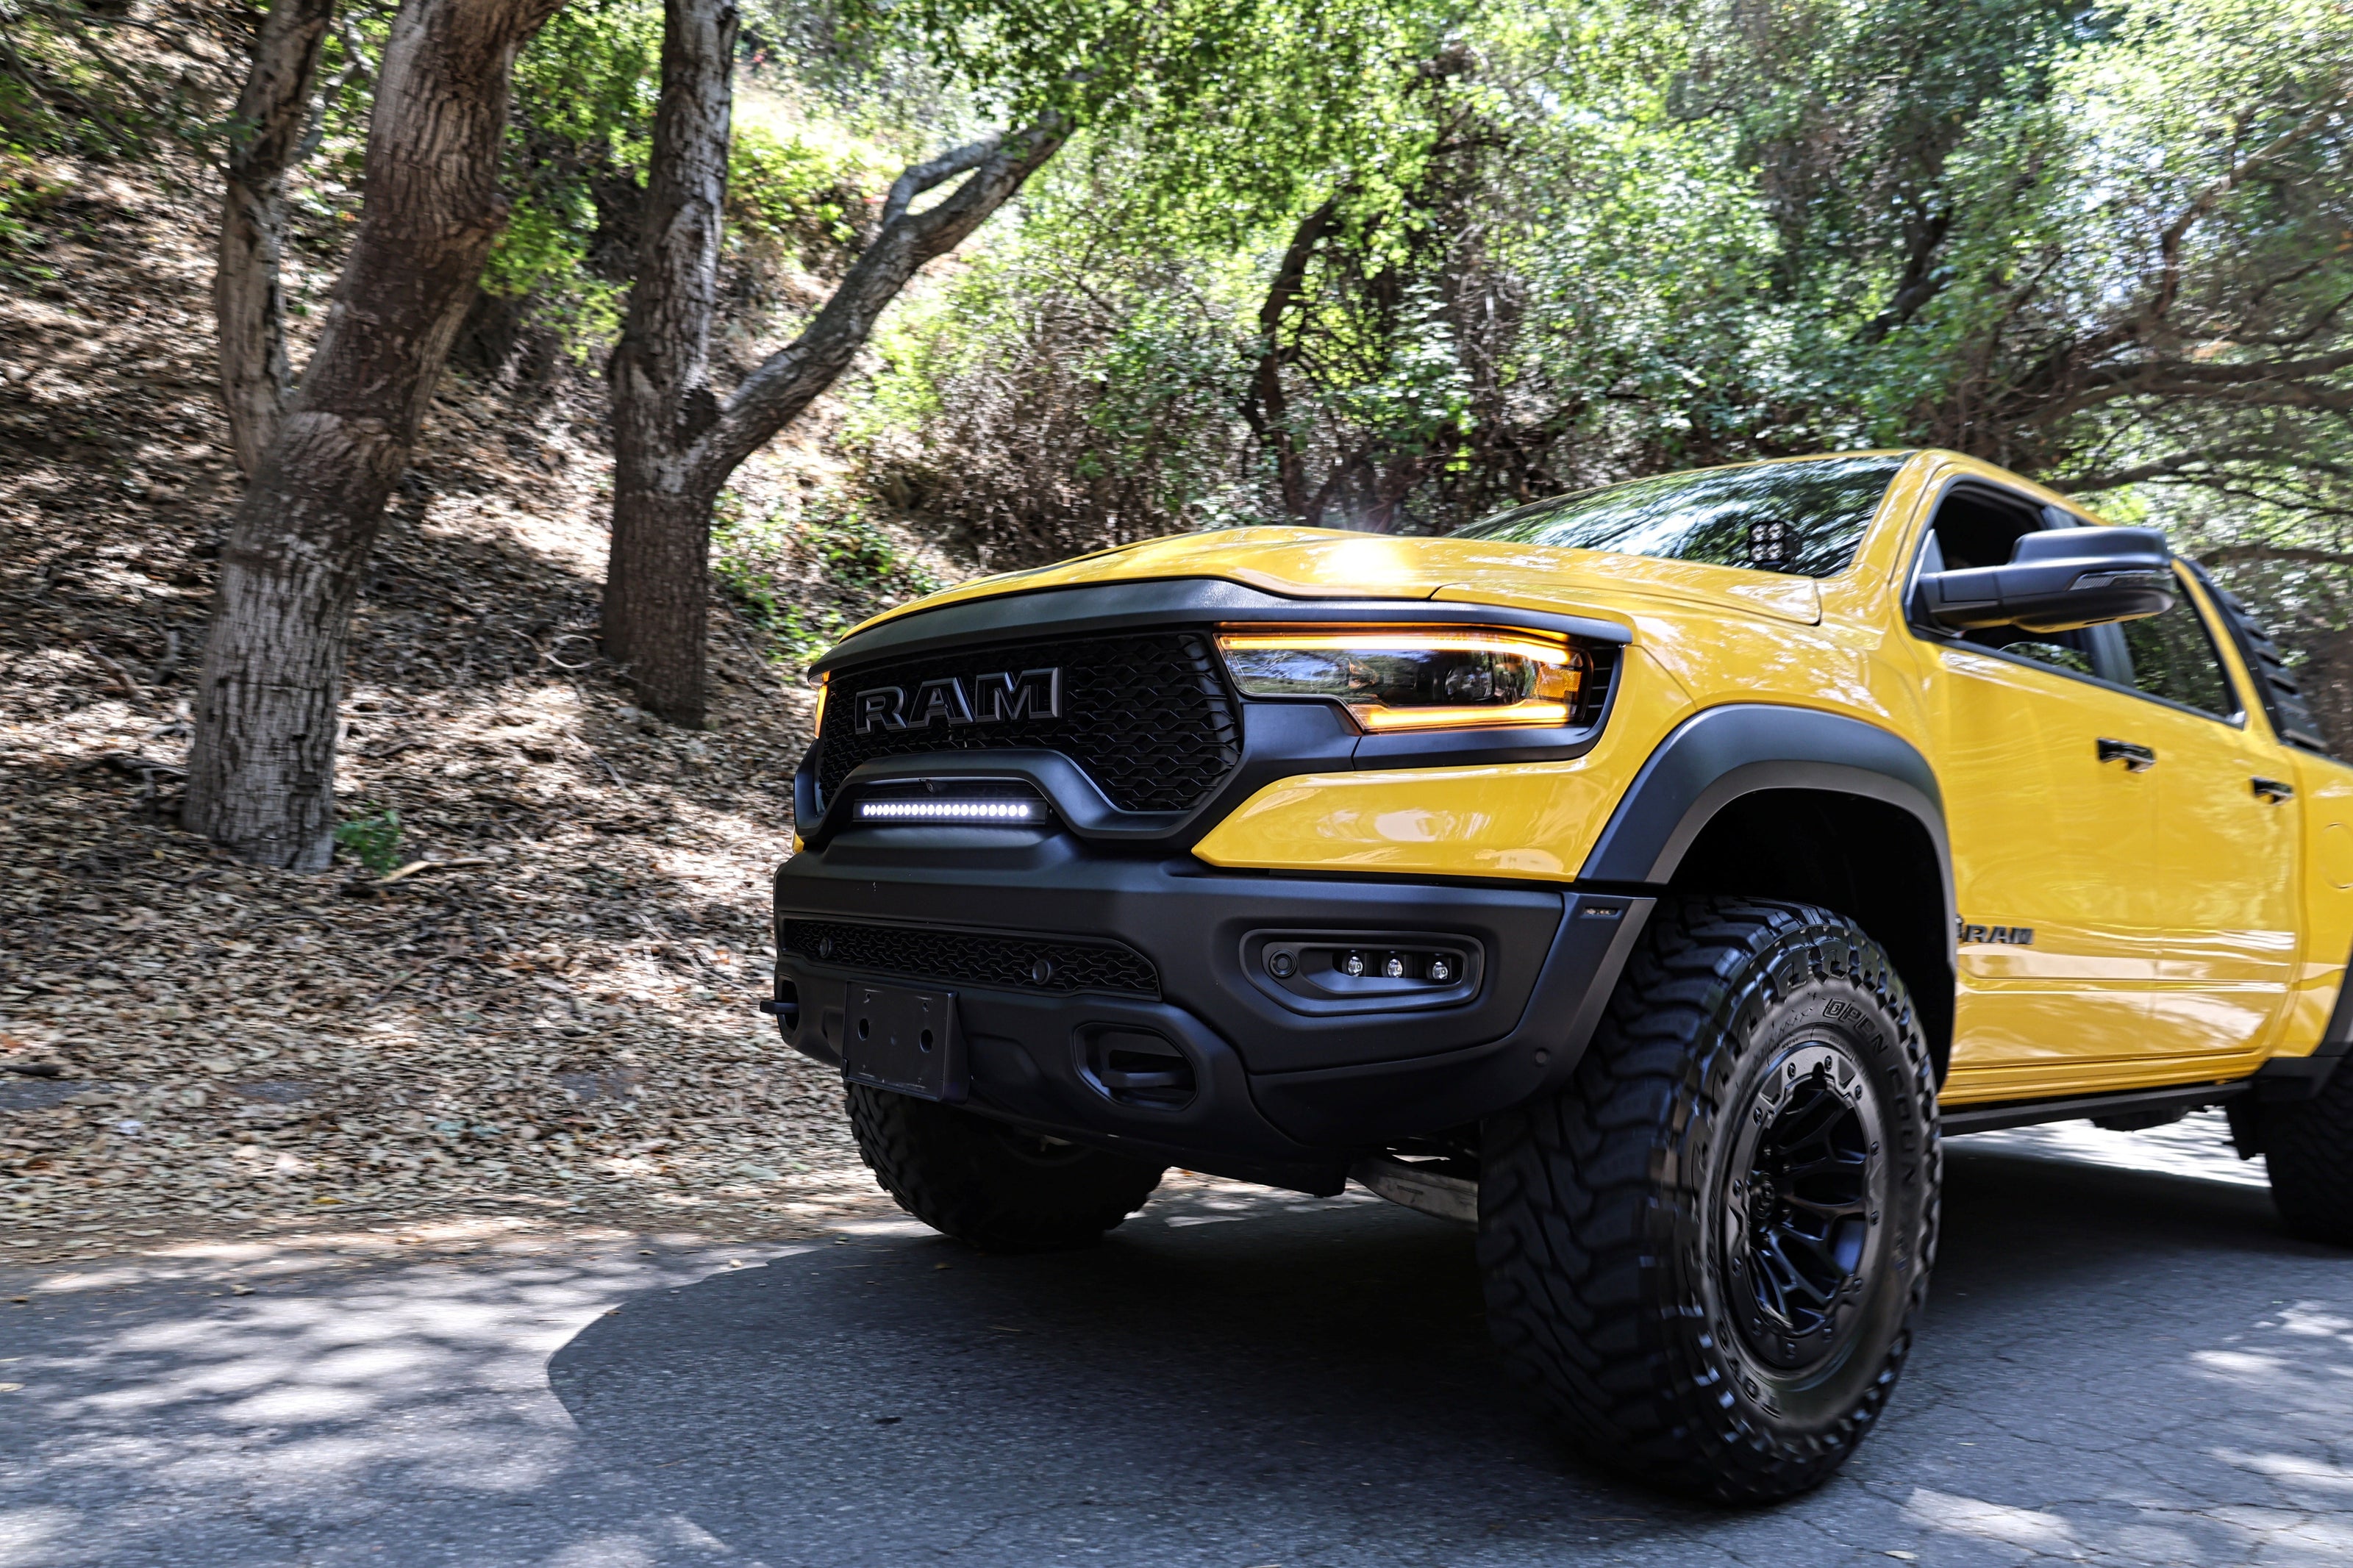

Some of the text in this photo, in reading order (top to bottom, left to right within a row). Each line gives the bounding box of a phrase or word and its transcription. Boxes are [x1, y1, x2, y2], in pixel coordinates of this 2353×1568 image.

[855, 667, 1063, 735] RAM
[1964, 924, 2034, 945] RAM
[1823, 998, 1888, 1054] OPEN
